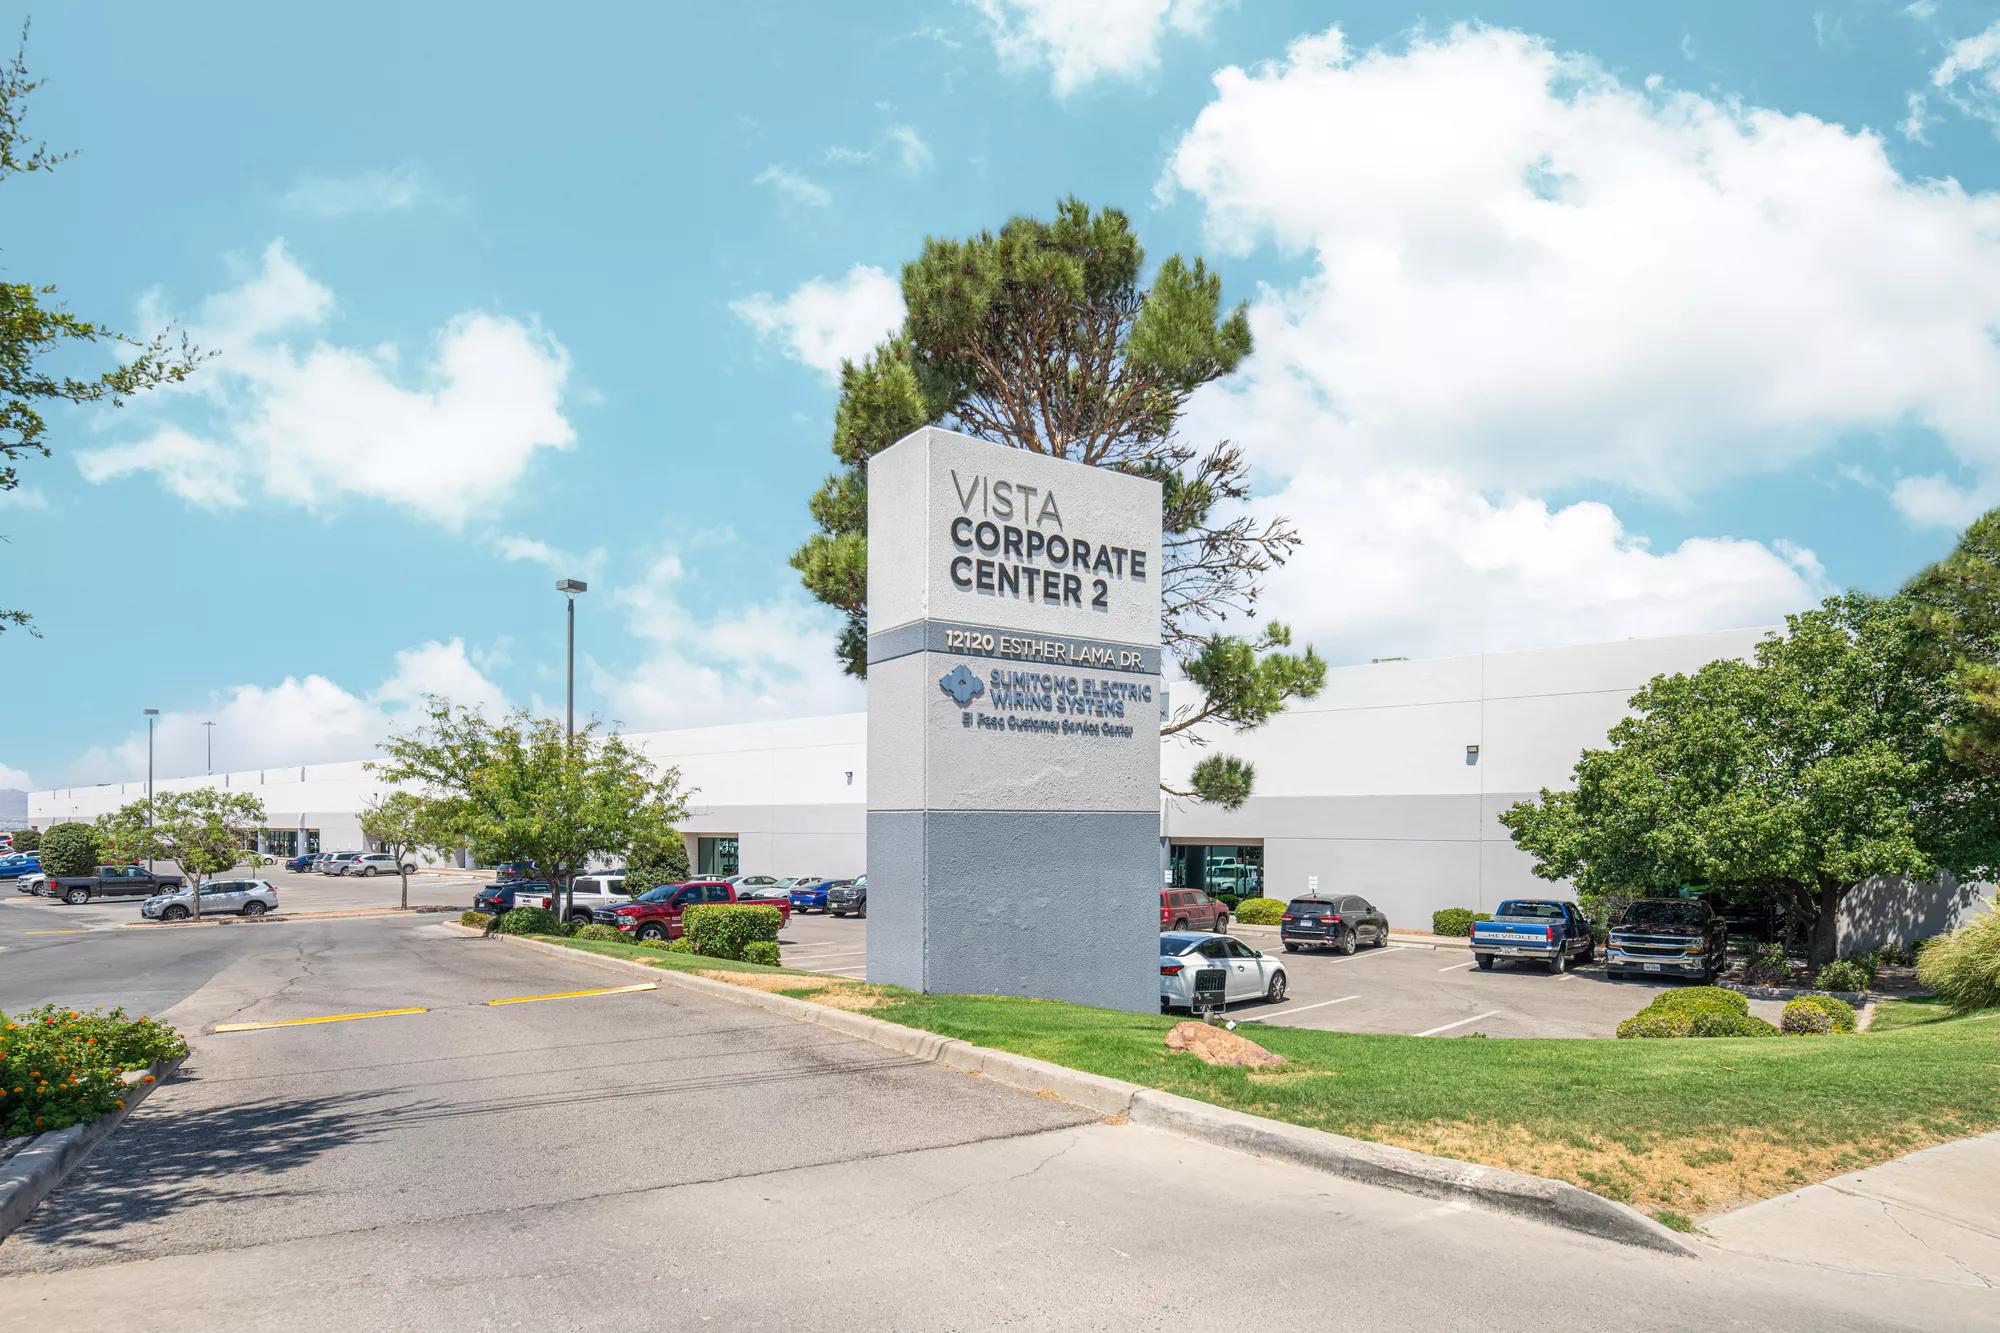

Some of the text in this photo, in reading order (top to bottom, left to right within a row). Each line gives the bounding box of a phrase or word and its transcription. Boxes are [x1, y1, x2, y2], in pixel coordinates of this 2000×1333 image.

[951, 469, 1063, 531] VISTA
[951, 516, 1147, 578] CORPORATE
[950, 556, 1108, 607] CENTER 2
[945, 630, 1145, 668] 12120 ESTHER LAMA DR.
[990, 668, 1152, 701] SUMITOMO ELECTRIC
[990, 688, 1124, 717] WIRING SYSTEMS
[962, 712, 1133, 737] El Paso Customer Service Center
[1483, 932, 1539, 941] HEVROLET
